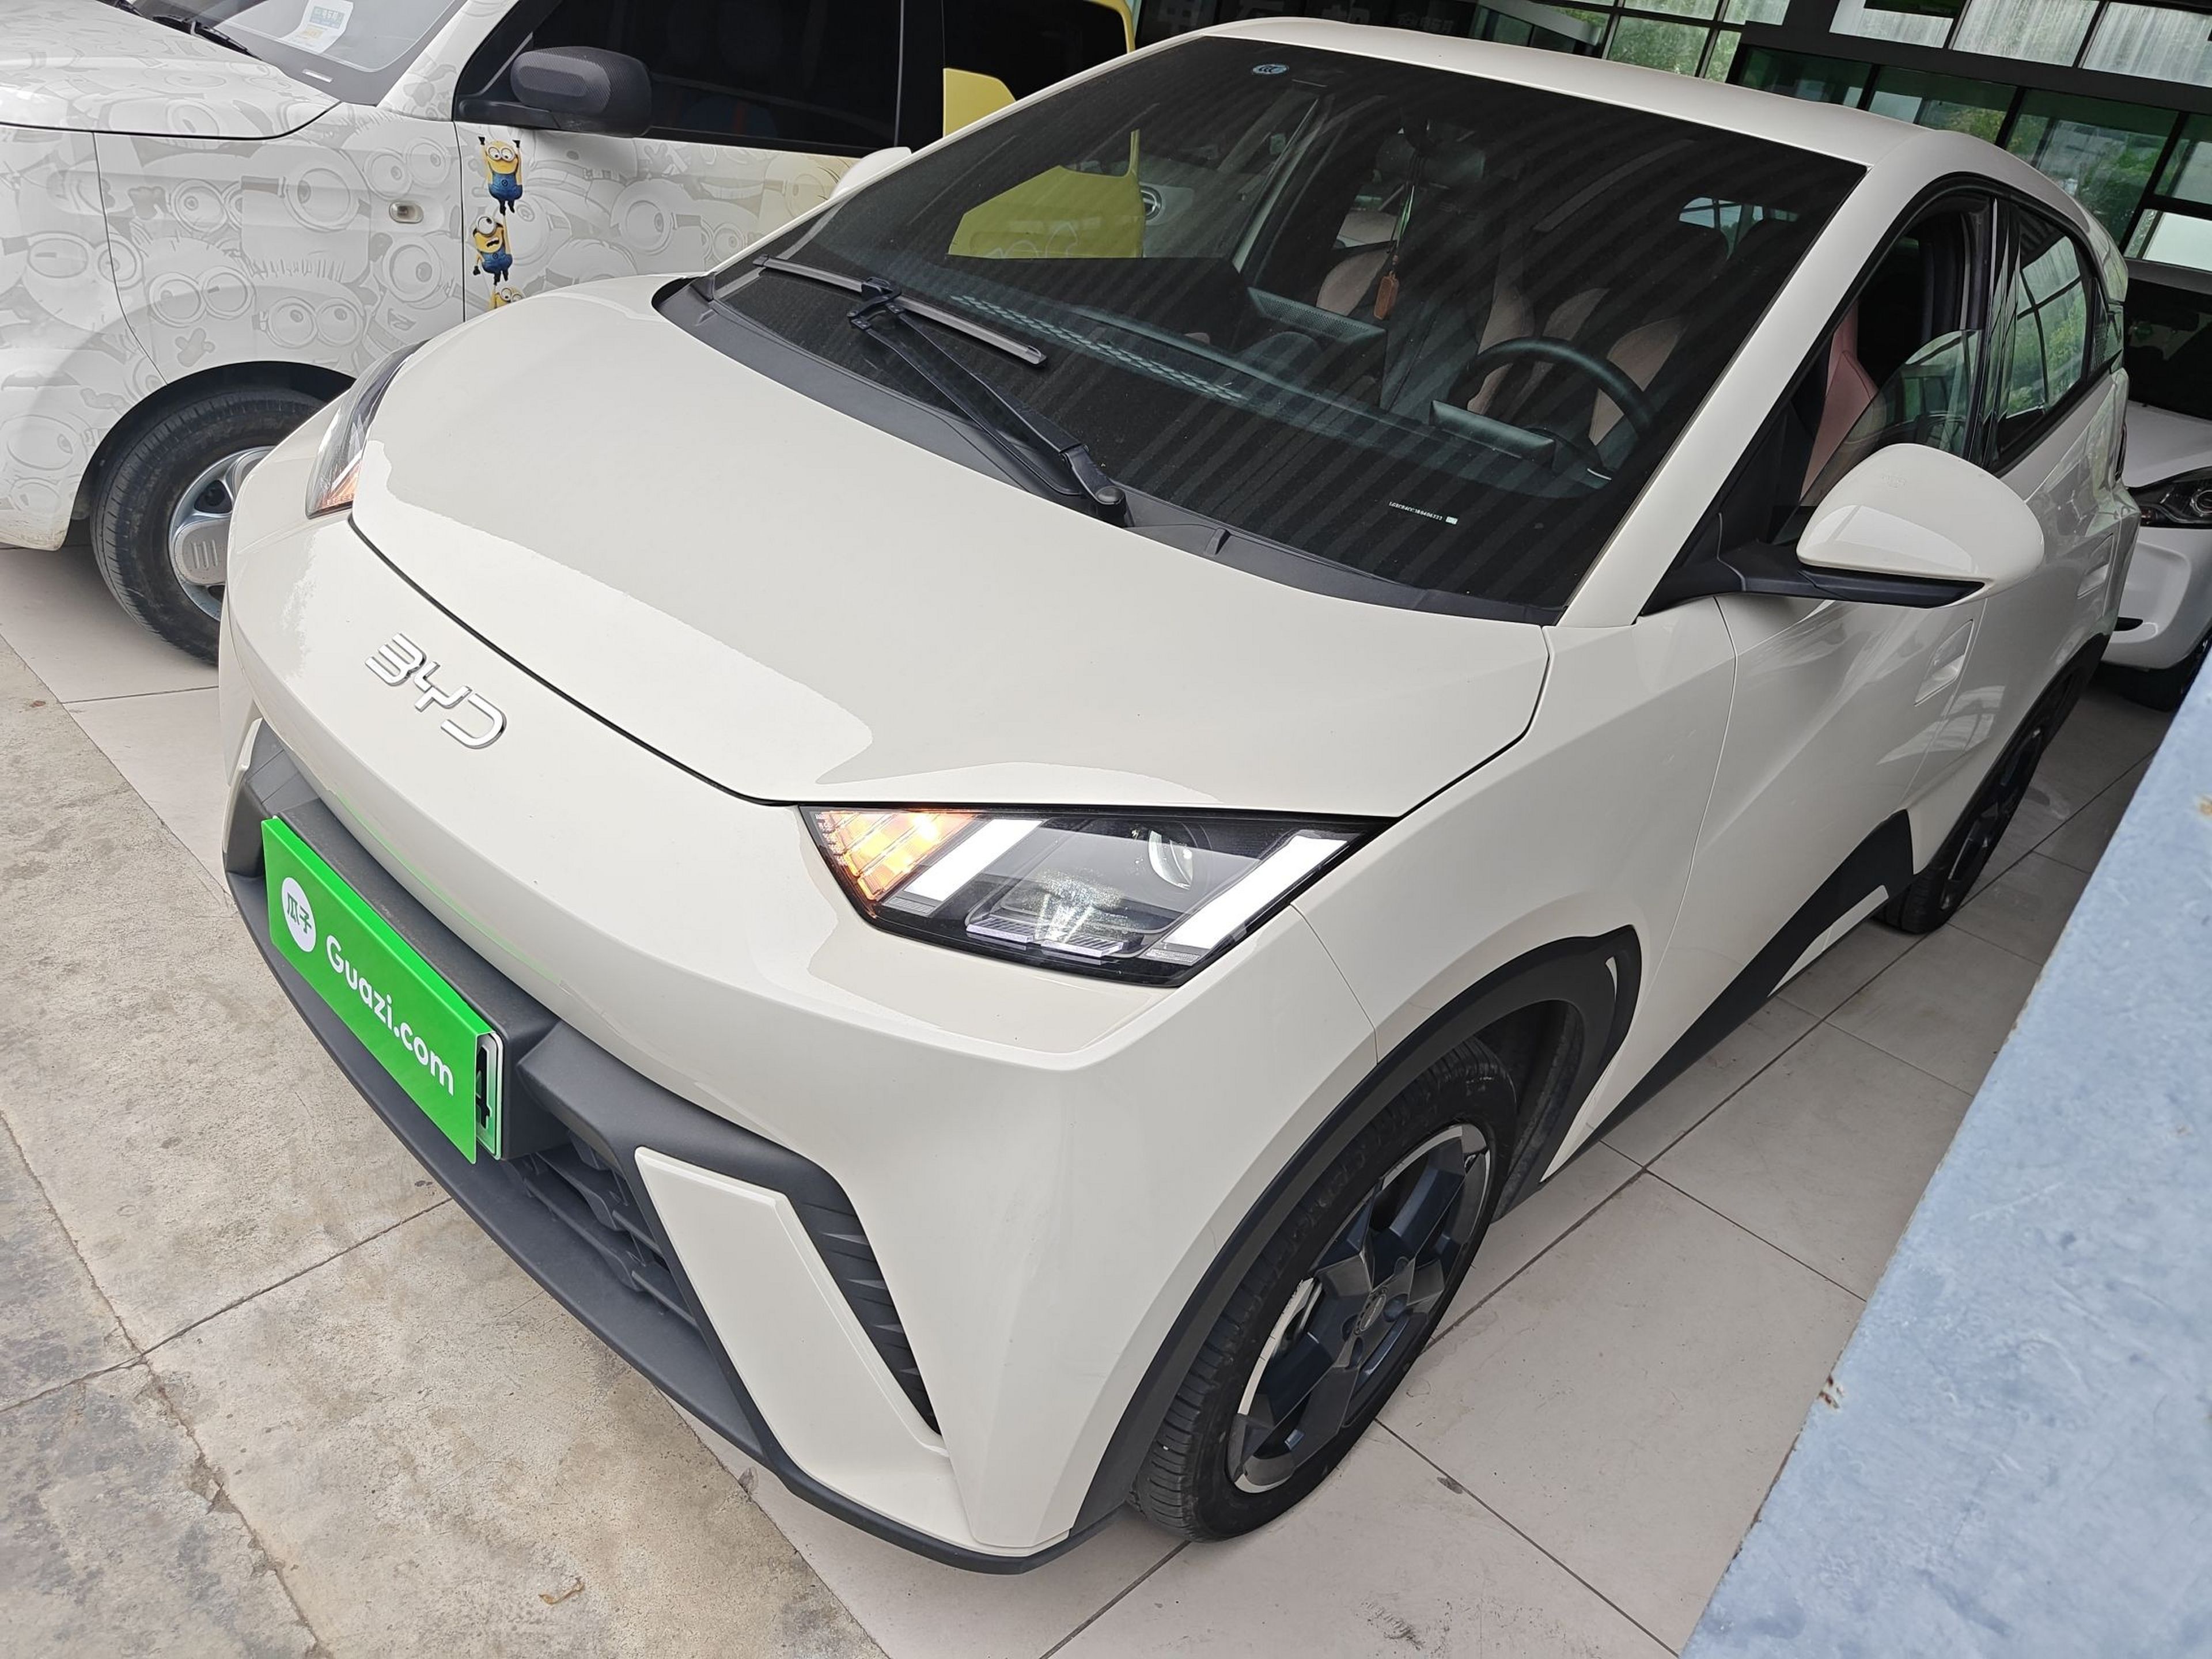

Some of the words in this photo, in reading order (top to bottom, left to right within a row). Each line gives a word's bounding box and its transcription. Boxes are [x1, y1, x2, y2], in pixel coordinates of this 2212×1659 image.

[365, 632, 507, 749] BYD
[287, 891, 312, 934] 瓜子
[326, 934, 454, 1096] Guazi.com
